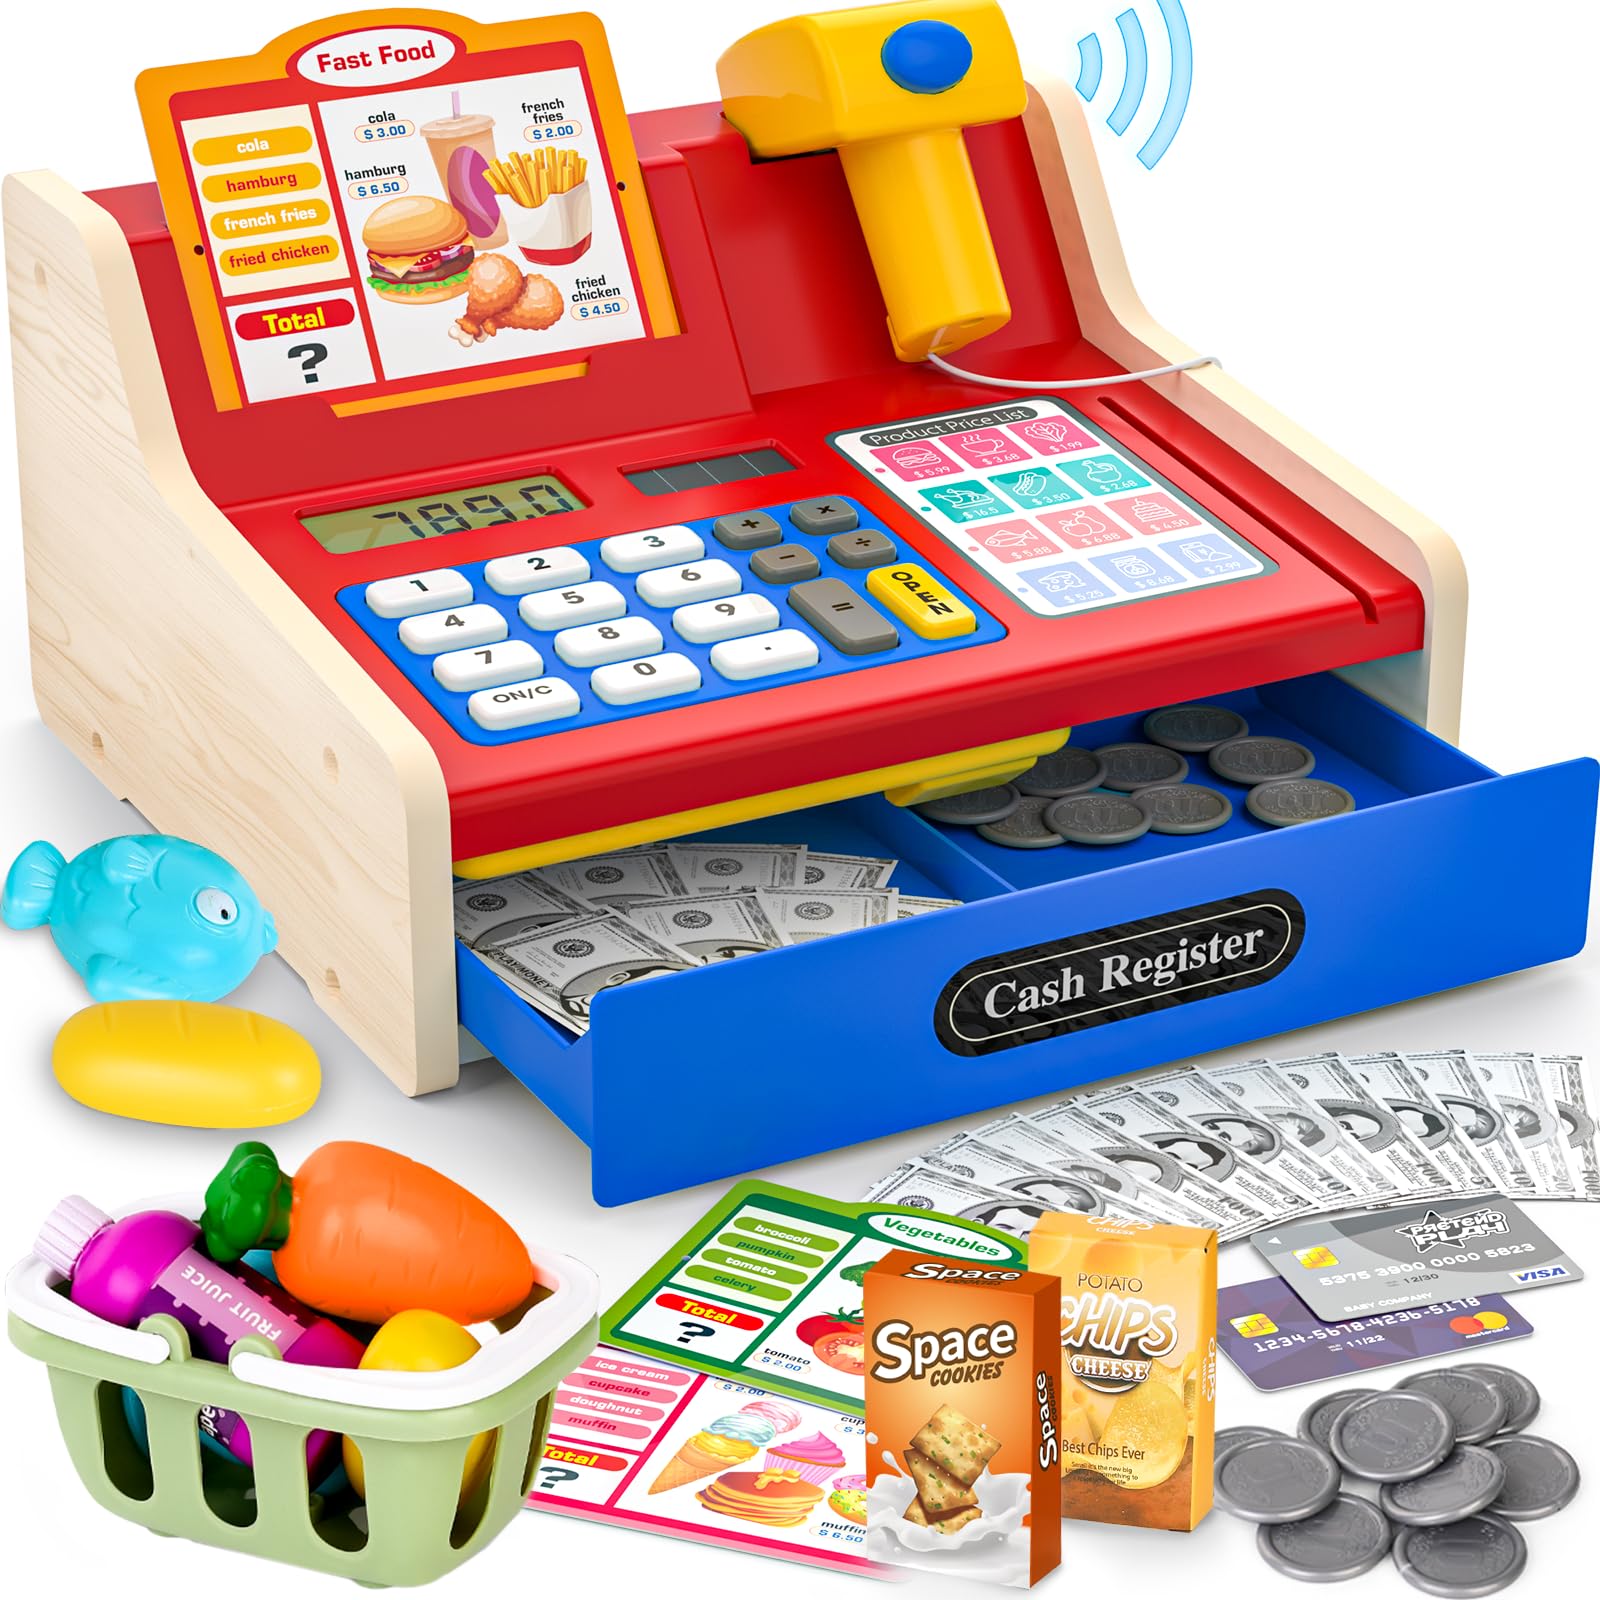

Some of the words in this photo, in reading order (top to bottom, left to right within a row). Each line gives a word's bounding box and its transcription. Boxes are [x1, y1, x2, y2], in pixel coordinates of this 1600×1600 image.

[316, 51, 371, 74] Fast
[379, 41, 436, 64] Food
[522, 99, 564, 114] french
[367, 110, 396, 123] cola
[532, 110, 563, 124] fries
[364, 129, 372, 139] $
[377, 124, 406, 137] 3.00
[533, 130, 541, 140] $
[545, 125, 574, 138] 2.00
[236, 136, 269, 154] cola
[344, 162, 406, 181] hamburg
[226, 171, 297, 193] hamburg
[357, 185, 367, 197] $
[372, 180, 400, 194] 6.50
[223, 209, 277, 231] french
[280, 206, 317, 224] fries
[229, 249, 266, 268] fried
[271, 242, 330, 263] chicken
[575, 275, 607, 290] fried
[571, 285, 620, 300] chicken
[579, 307, 588, 318] $
[591, 301, 621, 317] 4.50
[262, 307, 327, 334] Total
[287, 342, 329, 384] ?
[870, 424, 943, 445] Product
[946, 416, 994, 432] Price
[998, 408, 1029, 422] List
[1049, 444, 1059, 453] $
[913, 469, 922, 478] $
[925, 465, 951, 477] 5.99
[1100, 484, 1110, 493] $
[1032, 497, 1040, 506] $
[372, 483, 572, 540] 789.0
[962, 510, 972, 520] $
[1150, 522, 1159, 531] $
[645, 536, 665, 549] 3
[527, 557, 551, 571] 2
[681, 569, 701, 582] 6
[410, 579, 429, 593] 1
[890, 570, 955, 616] OPEN
[562, 591, 585, 605] 5
[1063, 592, 1073, 601] $
[715, 603, 736, 616] 9
[444, 614, 464, 628] 4
[599, 626, 621, 640] 8
[473, 650, 494, 665] 7
[632, 663, 656, 677] 0
[491, 684, 553, 705] ON/C
[494, 951, 518, 971] PLAY
[518, 967, 551, 989] MONEY
[984, 967, 1086, 1019] Cash
[1099, 927, 1264, 992] Register
[754, 1223, 810, 1245] broccoli
[883, 1217, 1001, 1257] Vegetables
[735, 1240, 796, 1263] pumpkin
[725, 1256, 777, 1276] tomato
[902, 1262, 1021, 1281] Space
[1319, 1270, 1370, 1286] 5375
[1375, 1260, 1426, 1278] 3900
[1430, 1251, 1480, 1268] 0000
[1487, 1243, 1536, 1259] 5823
[713, 1273, 756, 1292] celery
[1077, 1273, 1143, 1293] POTATO
[1403, 1273, 1439, 1284] 12/30
[1516, 1267, 1566, 1282] VISA
[180, 1265, 232, 1303] JUICE
[1343, 1300, 1378, 1312] BABY
[1378, 1292, 1433, 1306] COMPANY
[230, 1301, 281, 1340] FRUIT
[680, 1300, 738, 1325] Total
[676, 1321, 716, 1344] ?
[1061, 1292, 1178, 1357] CHIPS
[1346, 1334, 1386, 1347] 11/22
[764, 1347, 811, 1366] tomato
[871, 1319, 1017, 1383] Space
[761, 1354, 771, 1363] $
[774, 1358, 802, 1372] 2.00
[1070, 1356, 1150, 1381] CHEESE
[621, 1364, 670, 1381] cream
[930, 1360, 1005, 1387] COOKIES
[588, 1378, 651, 1399] cupcake
[570, 1394, 642, 1417] doughnut
[568, 1414, 617, 1432] muffin
[844, 1426, 852, 1434] $
[1037, 1371, 1058, 1472] Space
[543, 1445, 599, 1466] Total
[1062, 1440, 1085, 1454] Best
[1088, 1442, 1118, 1459] Chips
[1122, 1446, 1146, 1460] Ever
[819, 1528, 828, 1536] $
[831, 1530, 864, 1543] 6.50
[821, 1521, 866, 1536] muffin
